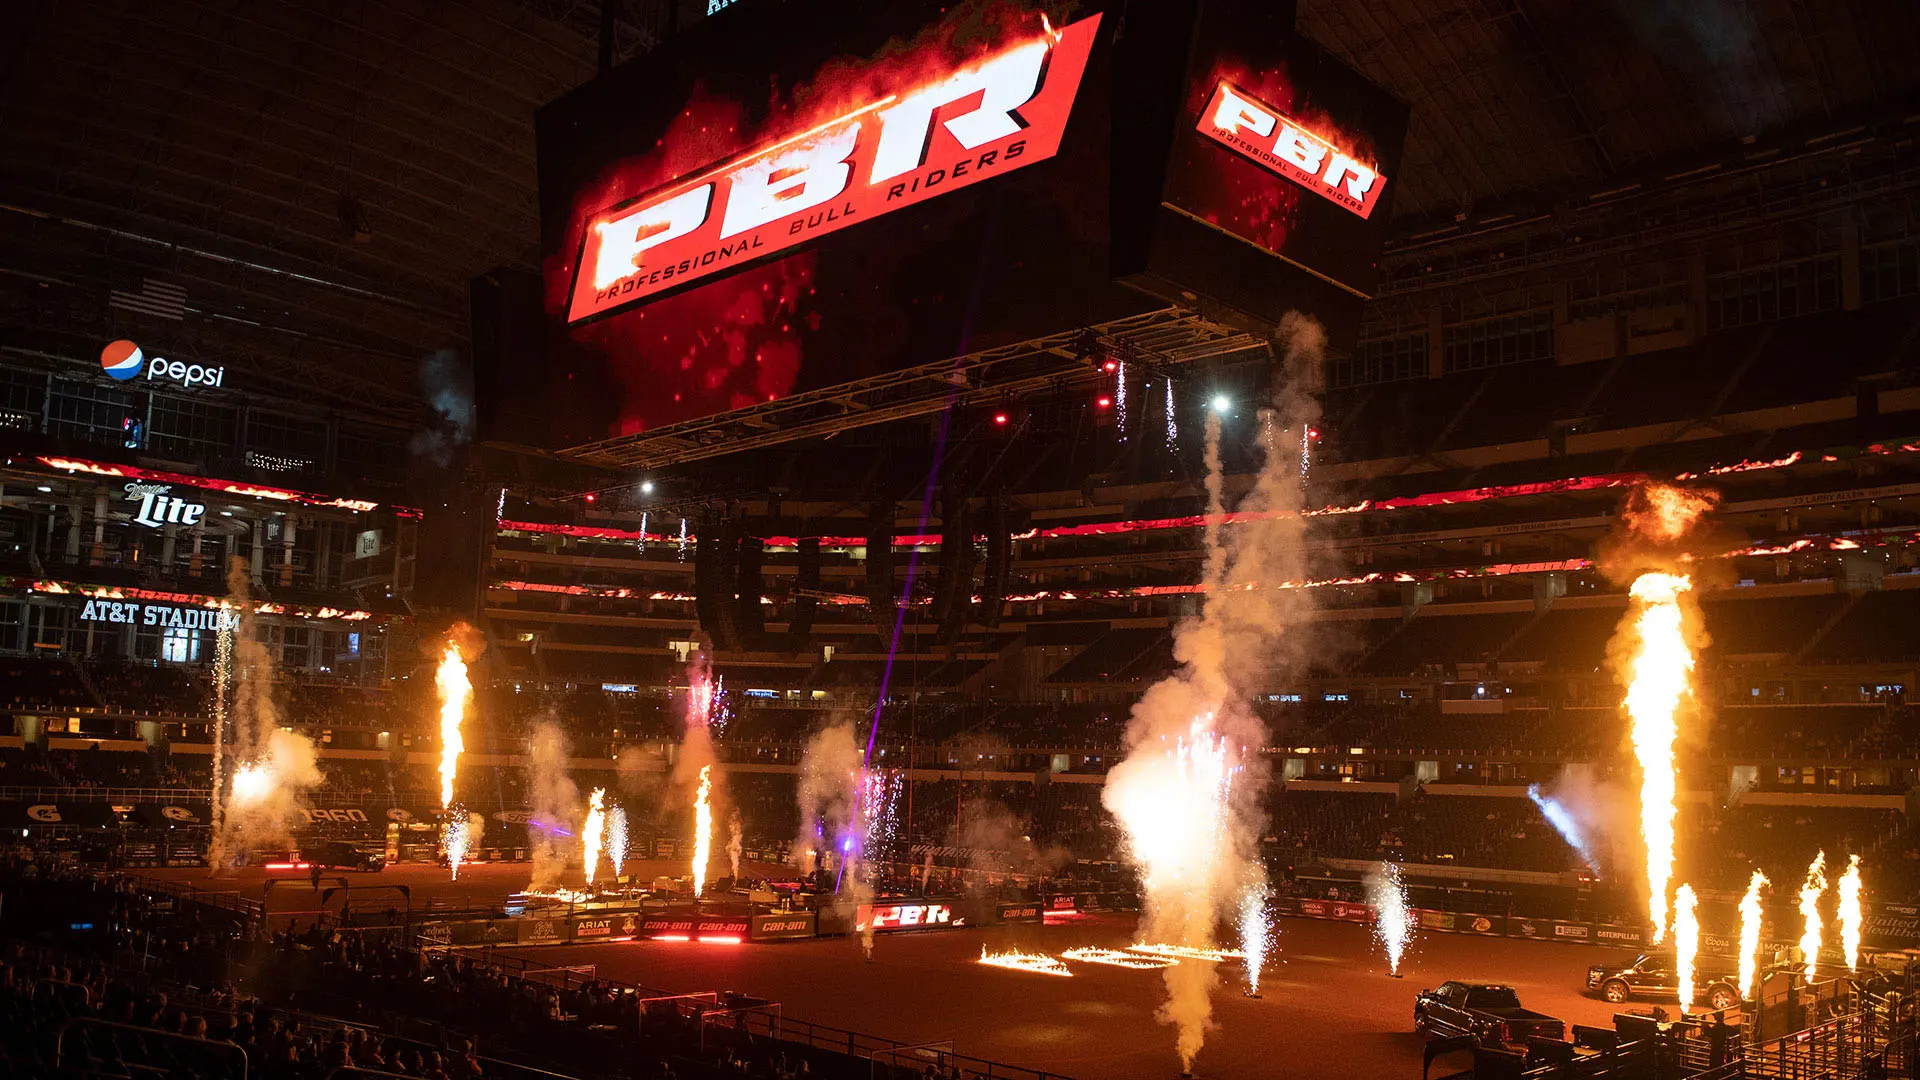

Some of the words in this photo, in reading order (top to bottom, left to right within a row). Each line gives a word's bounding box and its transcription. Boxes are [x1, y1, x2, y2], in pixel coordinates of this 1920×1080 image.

[1213, 84, 1377, 203] PBR
[596, 42, 1050, 290] PBR
[1212, 126, 1288, 172] PROFESSIONAL
[1295, 171, 1319, 188] BULL
[1326, 188, 1364, 212] RIDERS
[595, 236, 764, 304] PROFESSIONAL
[788, 202, 857, 237] BULL
[886, 141, 1028, 202] RIDERS
[147, 357, 224, 387] pepsi
[133, 492, 205, 528] Lite
[80, 600, 139, 624] AT&T
[143, 606, 241, 633] STADIUM
[1054, 896, 1075, 904] ARIAT
[871, 905, 950, 927] PBR
[1003, 907, 1037, 919] can-am
[577, 920, 611, 930] ARIAT
[643, 921, 693, 930] can-am
[698, 922, 748, 932] can-am
[762, 921, 807, 932] can-am
[1598, 930, 1640, 941] CATERPILLAR
[1705, 936, 1729, 947] Coors
[1764, 943, 1789, 952] MGM
